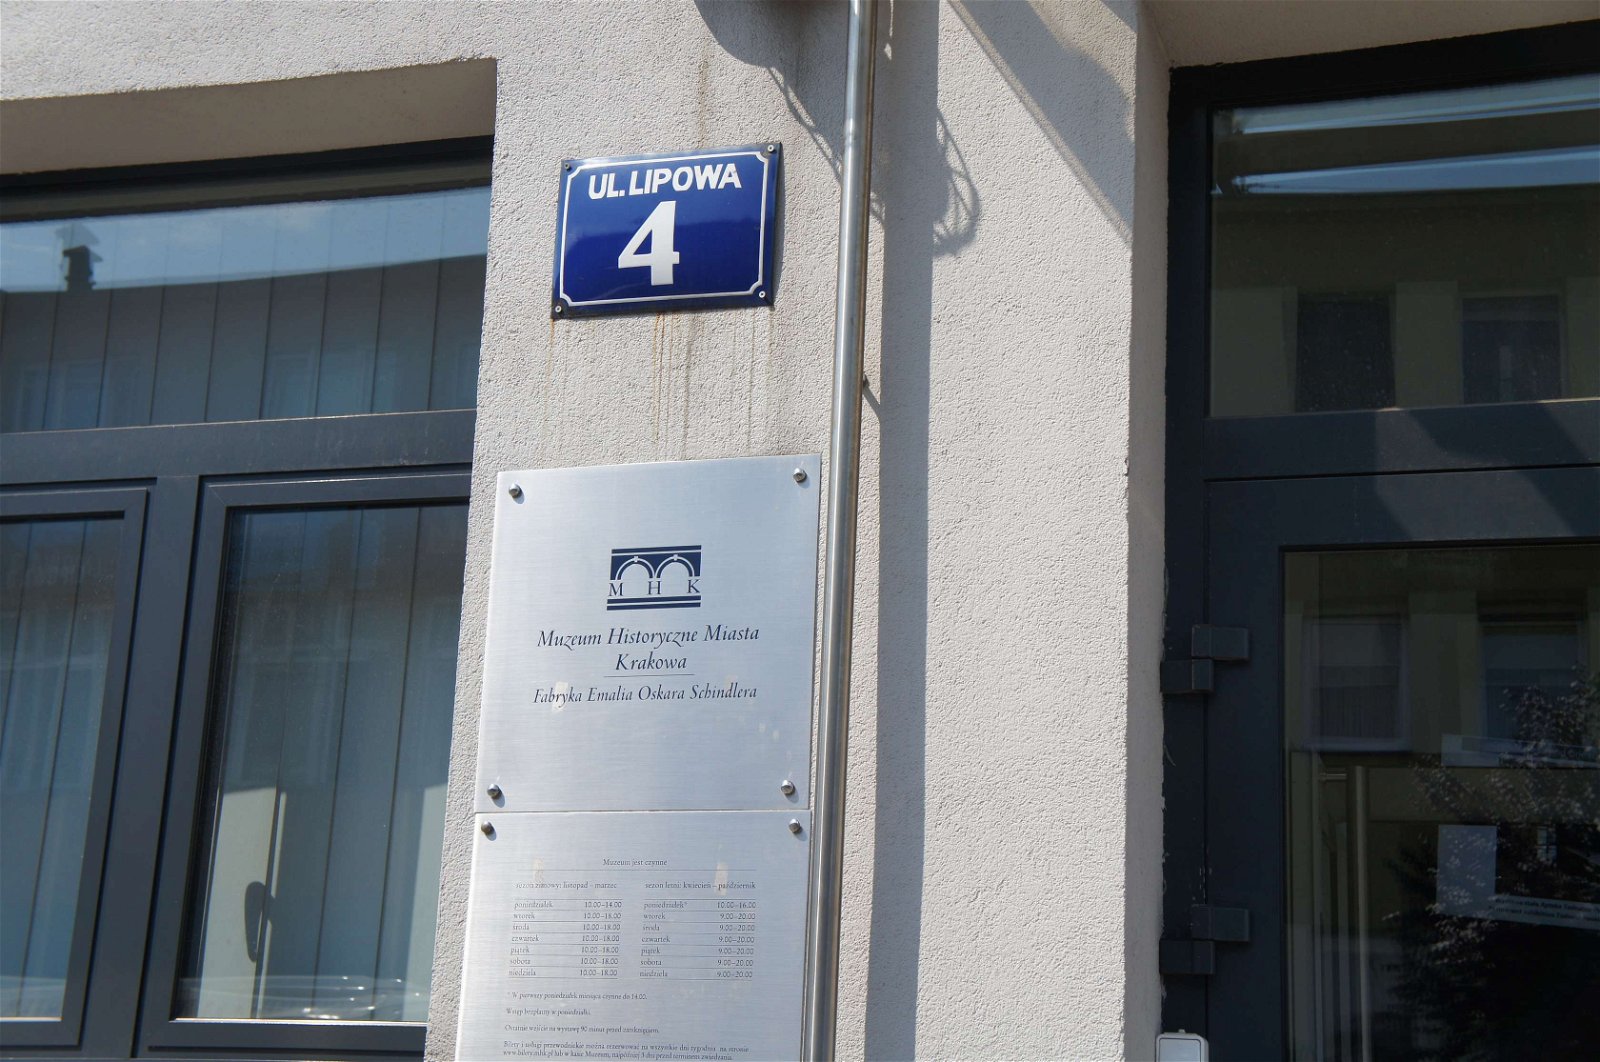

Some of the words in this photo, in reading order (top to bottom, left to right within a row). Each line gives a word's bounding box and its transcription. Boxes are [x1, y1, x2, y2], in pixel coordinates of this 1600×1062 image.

[588, 173, 624, 200] UL.
[628, 163, 742, 196] LIPOWA
[618, 200, 680, 286] 4
[537, 630, 602, 651] Muzeum
[606, 627, 698, 650] Historyczne
[703, 623, 760, 642] Miasta
[615, 651, 688, 671] Krakowa
[532, 681, 582, 709] Fabryka
[587, 685, 633, 702] Emalia
[638, 683, 685, 701] Oskara
[689, 681, 758, 700] Schindlera
[602, 858, 631, 867] Muzeum
[631, 859, 643, 868] jest
[644, 860, 668, 868] czynne
[563, 881, 589, 891] listopad
[665, 881, 682, 889] letni:
[683, 881, 712, 889] kwiecień
[718, 881, 756, 891] październik
[514, 900, 554, 909] poniedziałek
[513, 911, 535, 919] wtorek
[512, 923, 530, 931] środa
[511, 934, 539, 942] czwartek
[510, 946, 530, 955] piątek
[509, 957, 531, 965] sobota
[508, 968, 536, 976] niedziela
[544, 991, 578, 1000] poniedziałek
[622, 992, 631, 1000] do
[605, 1026, 622, 1034] przed
